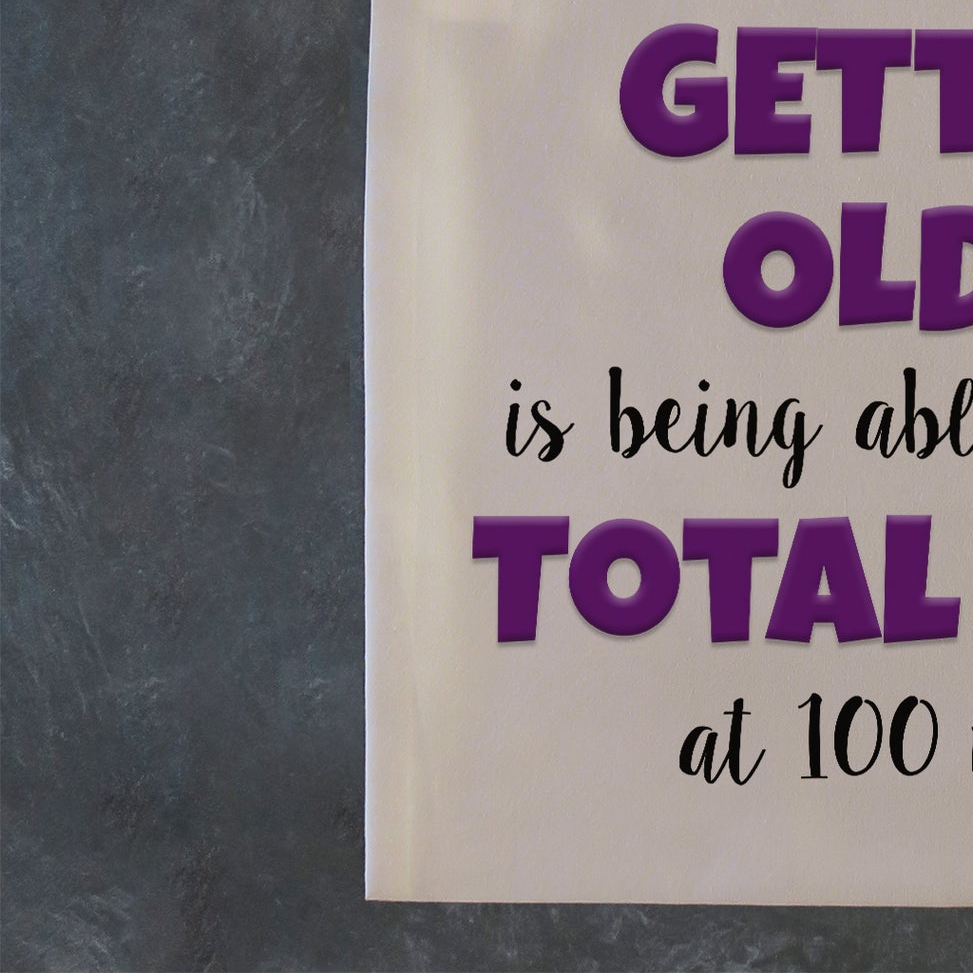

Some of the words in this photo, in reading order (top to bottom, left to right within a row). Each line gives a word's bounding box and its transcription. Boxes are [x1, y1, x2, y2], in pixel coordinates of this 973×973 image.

[505, 378, 575, 463] is
[608, 366, 824, 489] being
[472, 514, 961, 645] TOTAL
[679, 697, 767, 786] at
[797, 692, 939, 779] 100
